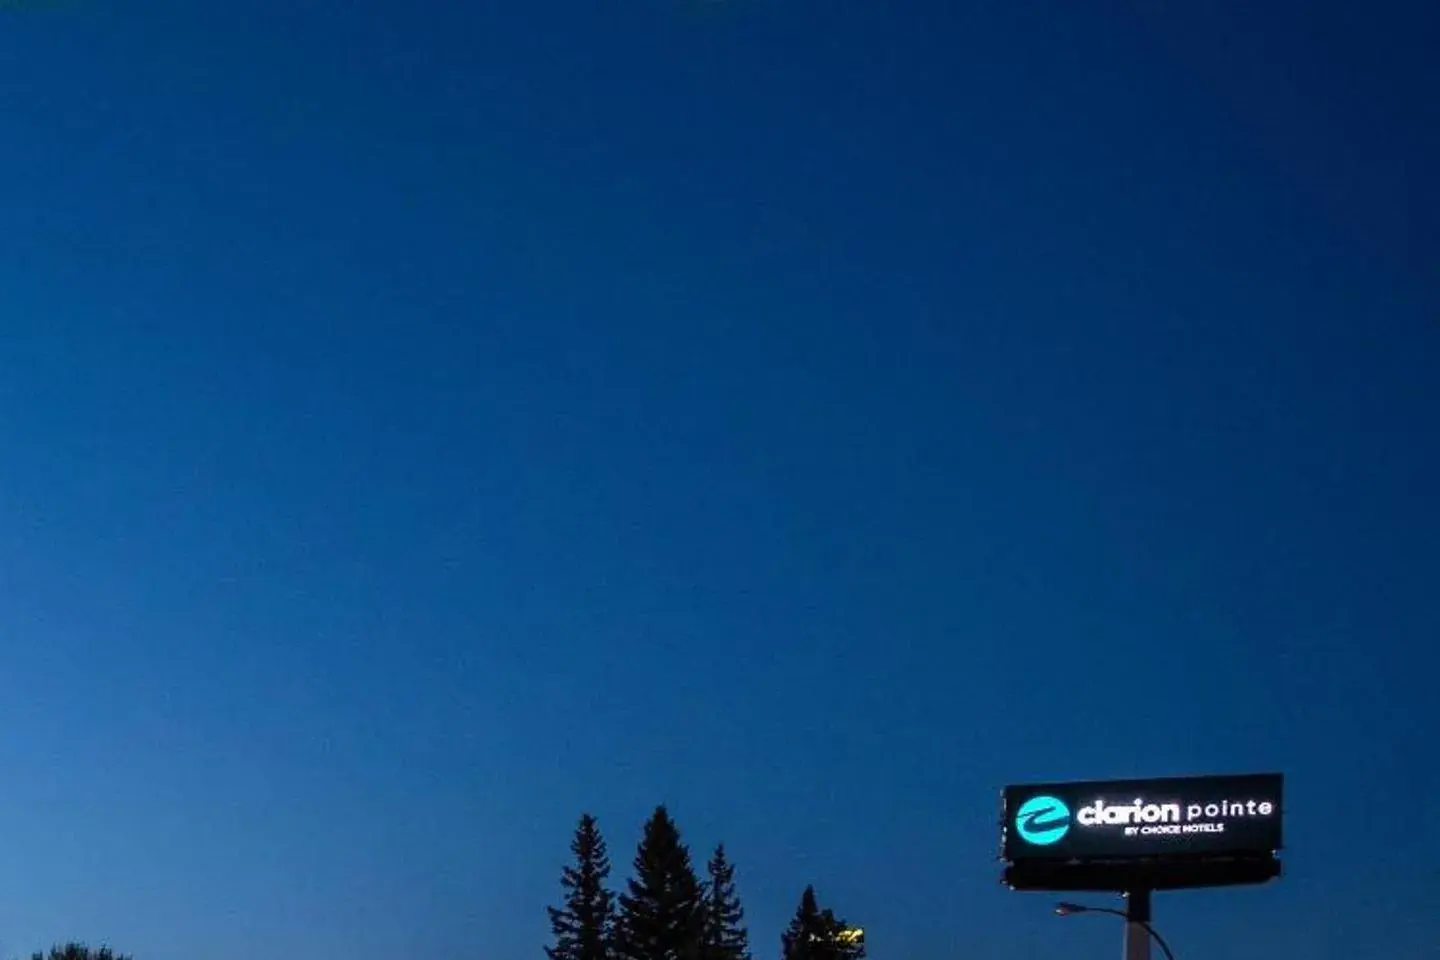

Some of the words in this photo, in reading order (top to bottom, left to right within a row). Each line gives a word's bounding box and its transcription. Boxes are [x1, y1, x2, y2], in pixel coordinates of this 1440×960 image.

[1077, 799, 1180, 824] clarion
[1187, 800, 1272, 820] pointe
[1141, 825, 1182, 834] CHOICE
[1183, 823, 1224, 833] HOTELS
